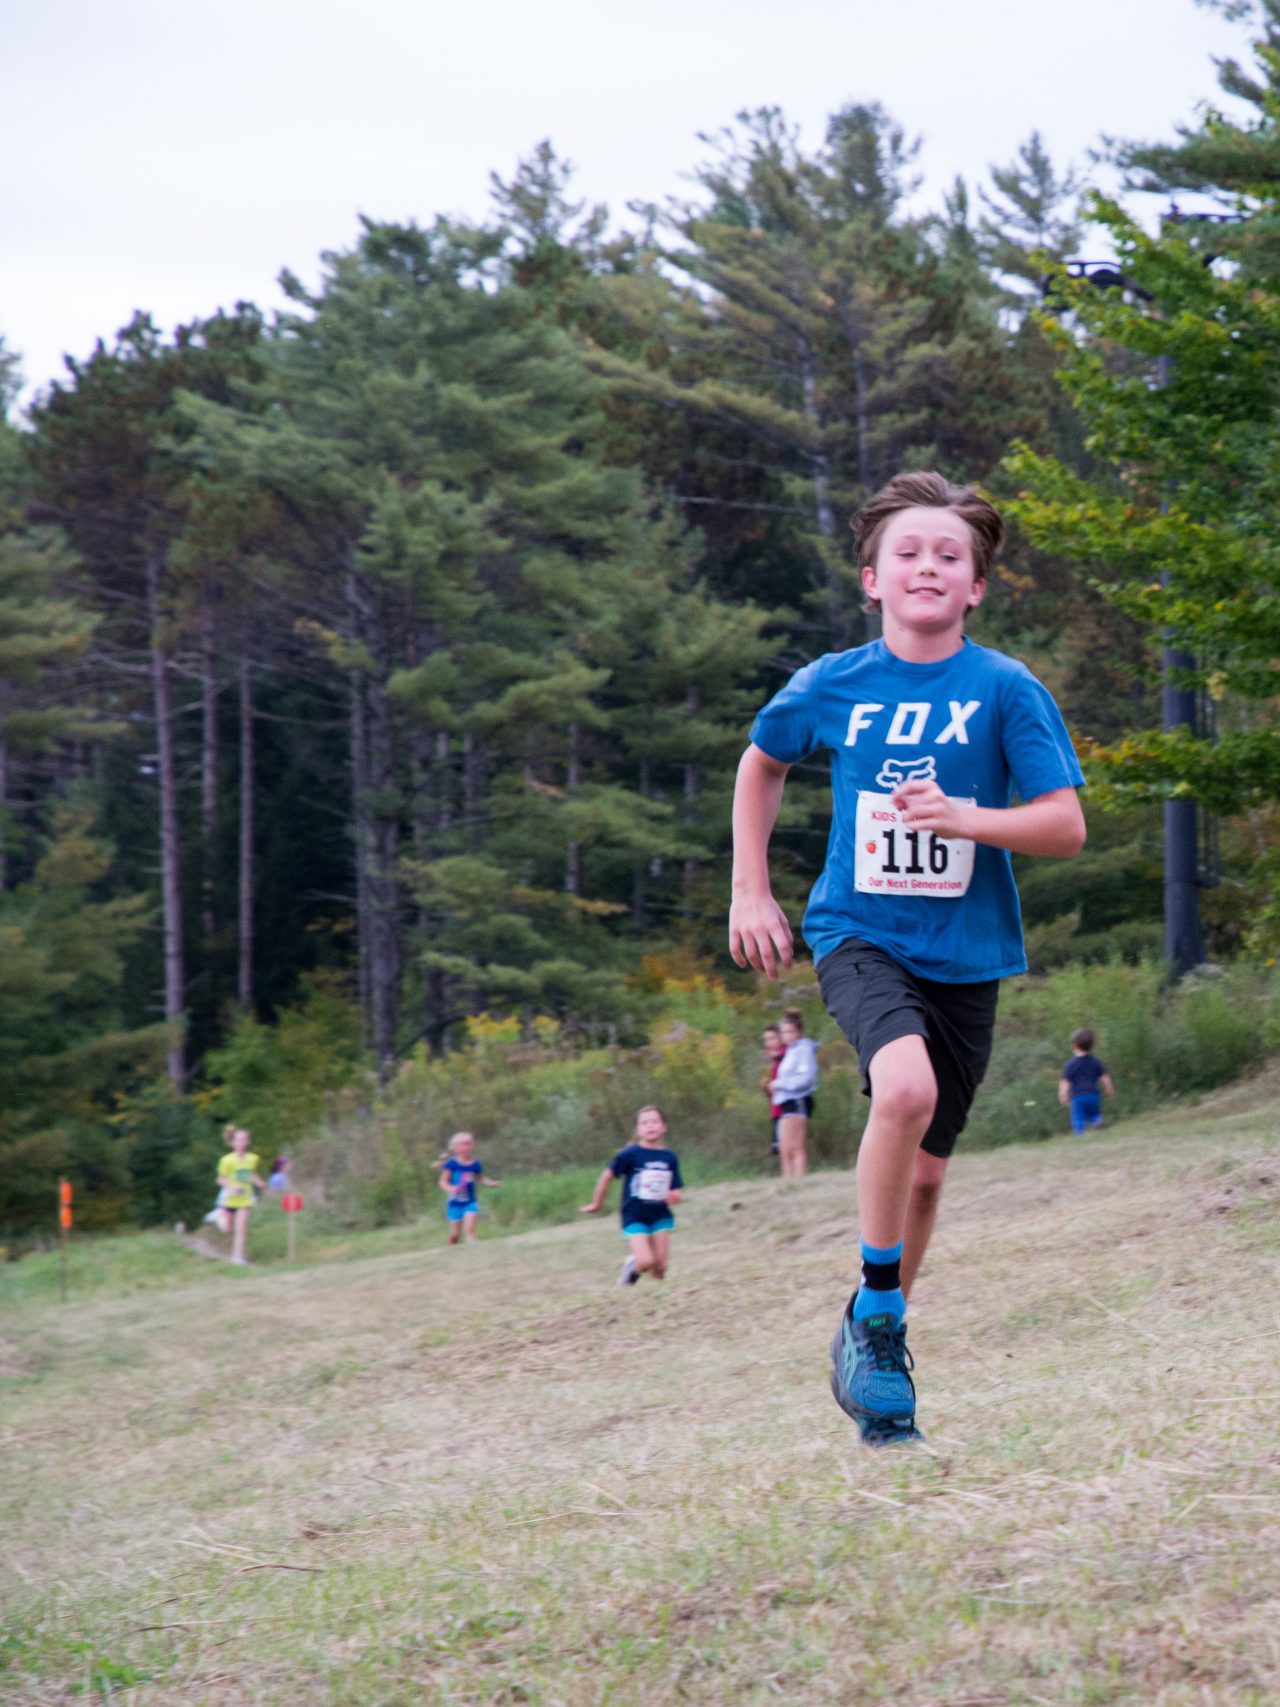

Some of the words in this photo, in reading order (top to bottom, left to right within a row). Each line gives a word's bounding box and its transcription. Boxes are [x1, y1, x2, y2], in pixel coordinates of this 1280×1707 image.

[845, 701, 982, 746] FOX
[871, 811, 897, 822] KIDS
[882, 828, 948, 874] 116
[868, 878, 883, 888] Our
[887, 879, 908, 889] Next
[911, 880, 962, 890] Generation
